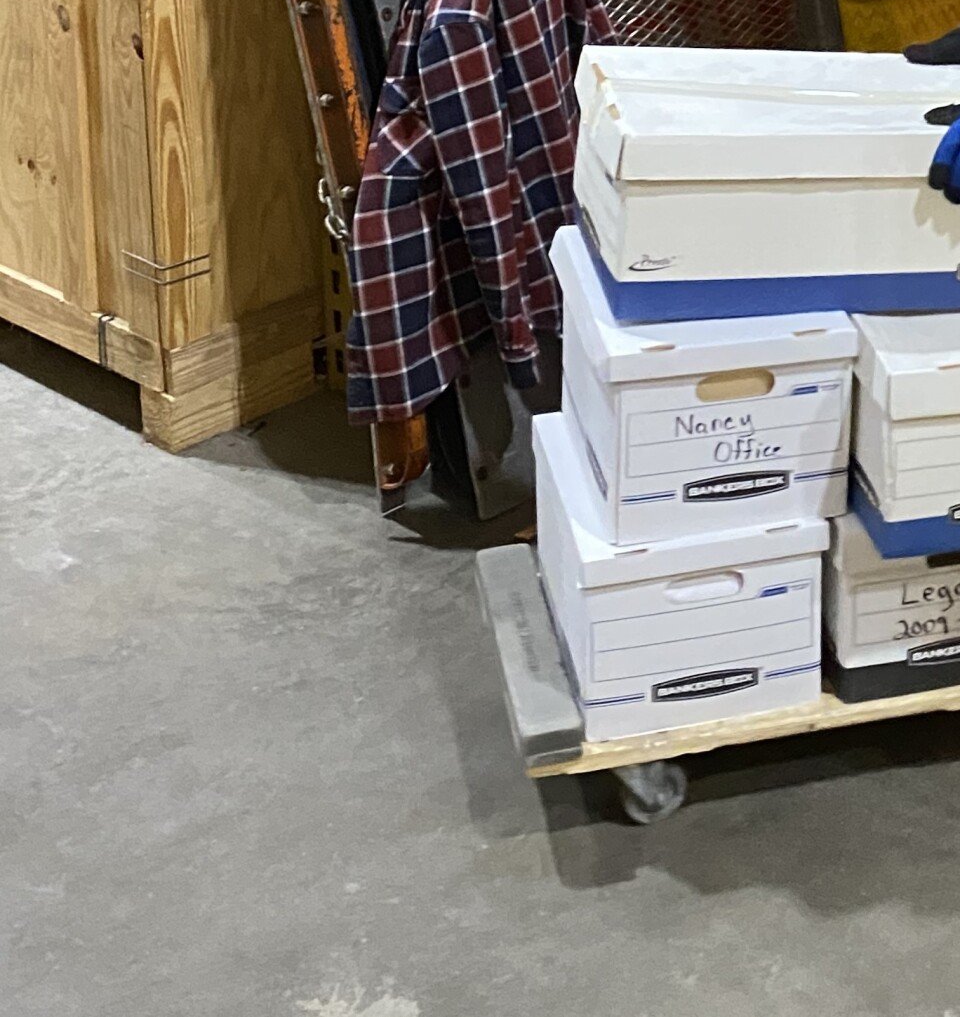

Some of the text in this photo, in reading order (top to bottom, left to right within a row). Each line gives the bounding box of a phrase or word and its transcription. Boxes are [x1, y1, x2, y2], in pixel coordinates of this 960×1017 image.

[674, 414, 755, 438] Nancy
[713, 437, 782, 463] Office
[754, 475, 785, 488] BOX
[723, 672, 754, 684] BOX
